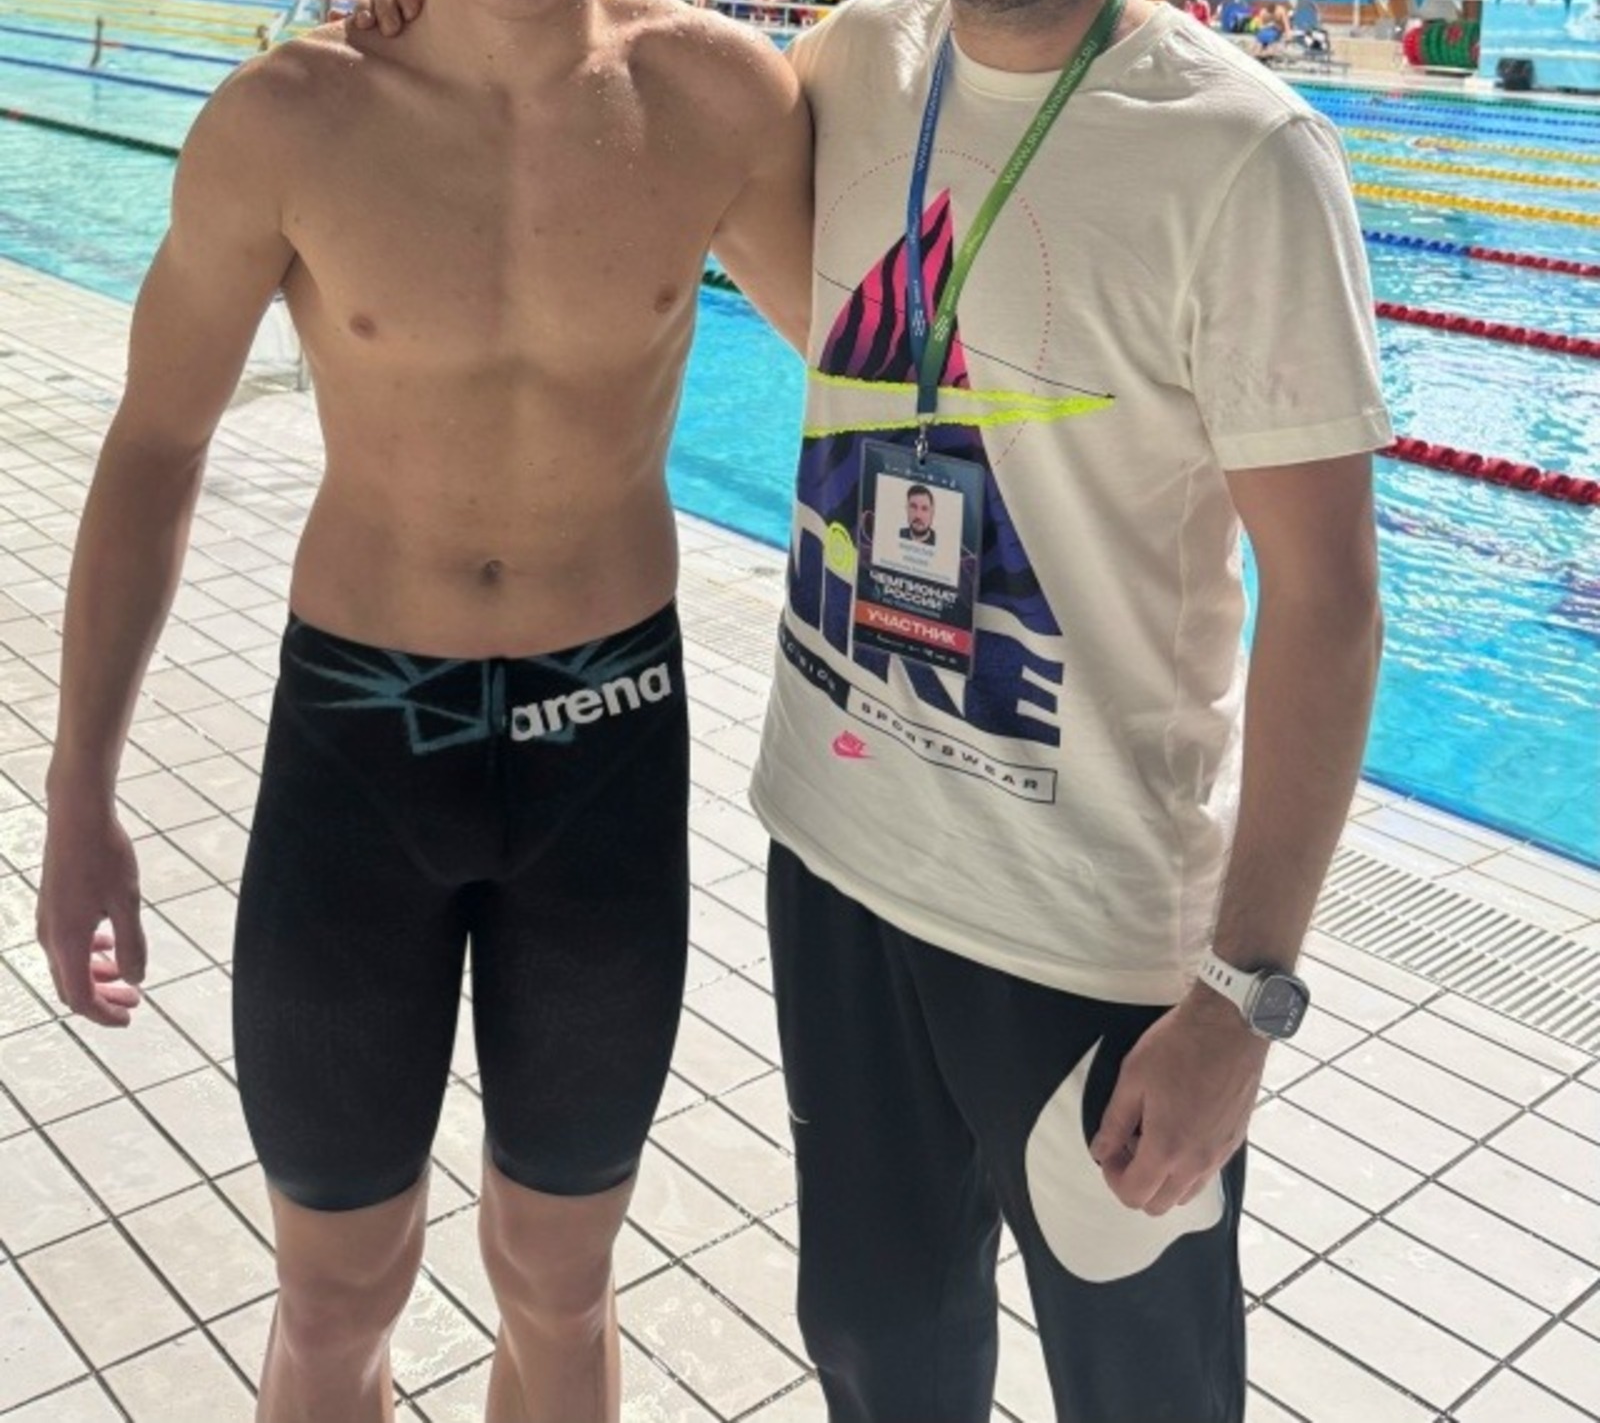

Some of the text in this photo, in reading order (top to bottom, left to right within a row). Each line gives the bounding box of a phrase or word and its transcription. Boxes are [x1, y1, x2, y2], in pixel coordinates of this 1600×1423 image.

[869, 569, 959, 605] ЧЕМПИОНАТ
[867, 607, 957, 647] УЧАСТНИК
[510, 662, 673, 743] arena
[861, 701, 1039, 791] SPORTSWEAR
